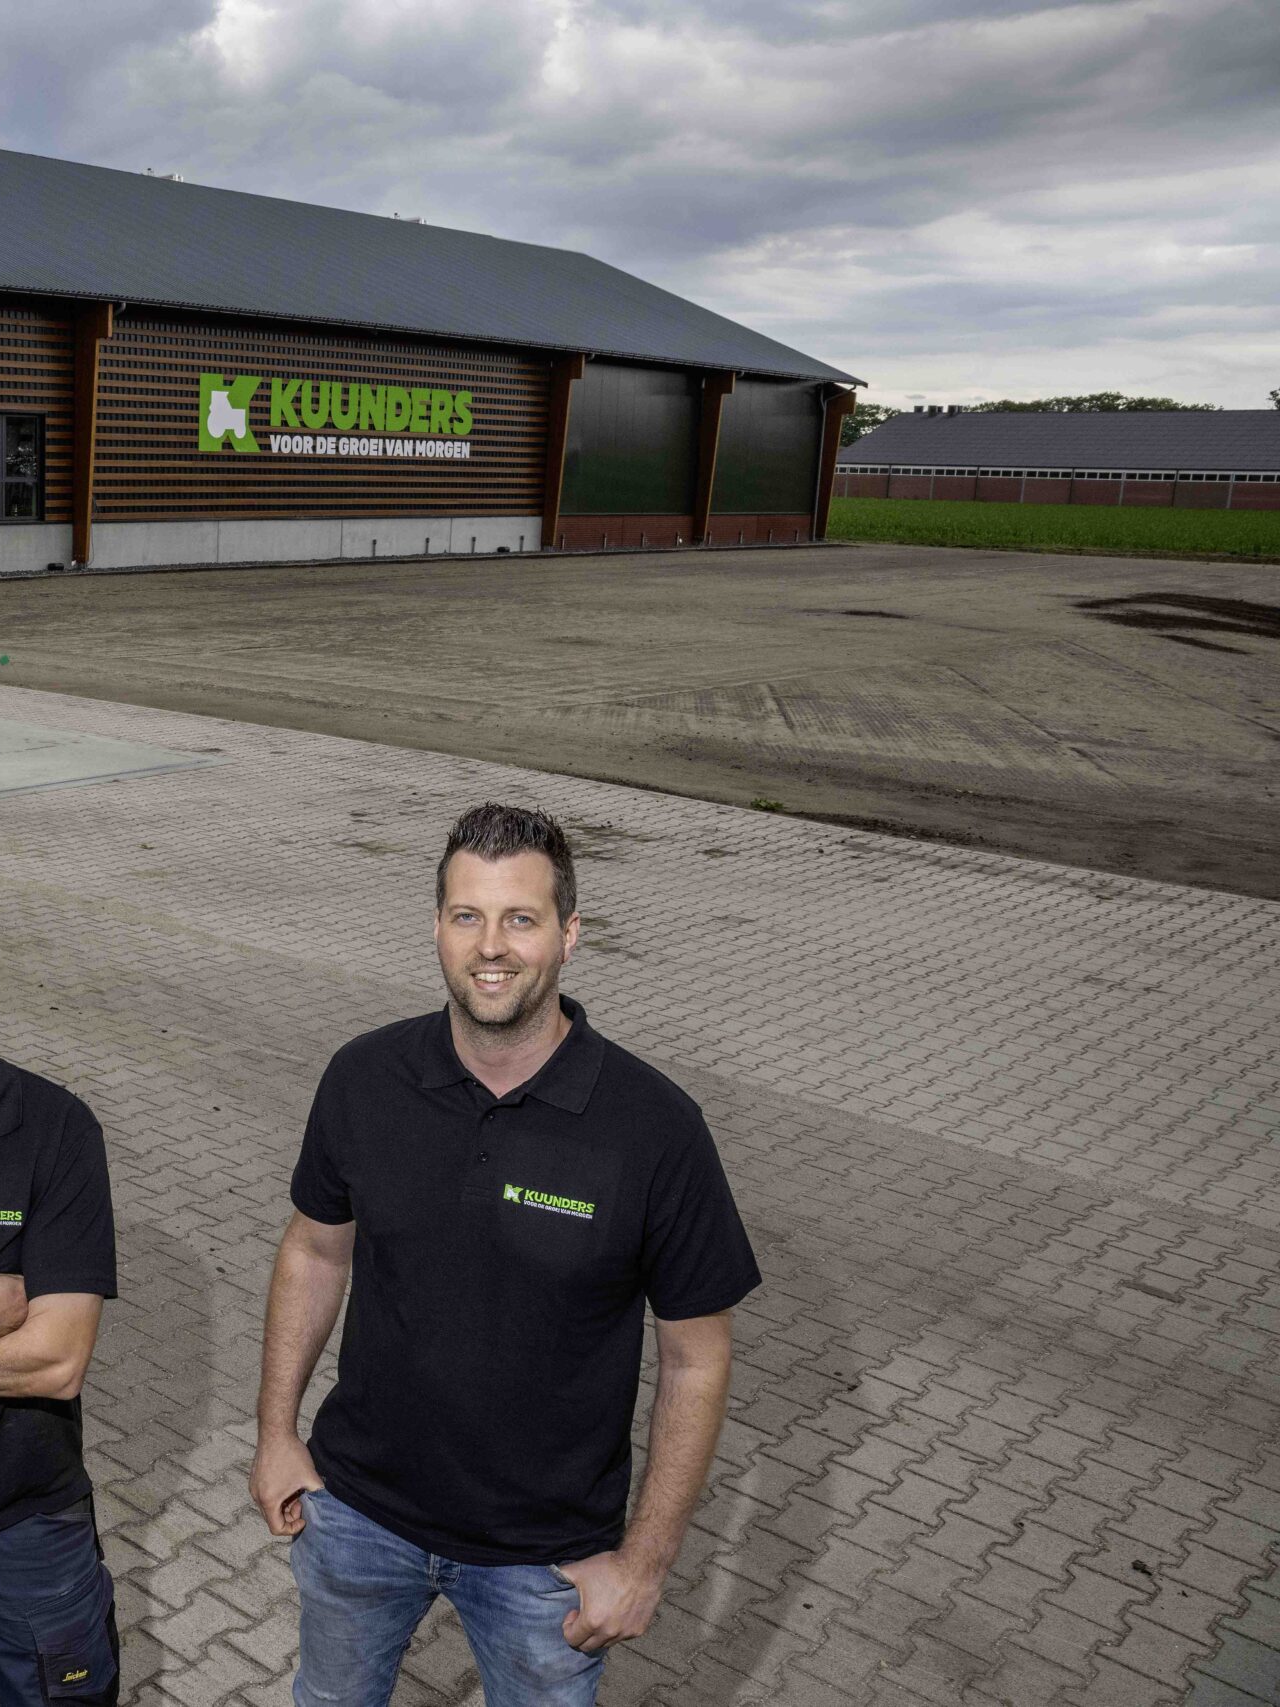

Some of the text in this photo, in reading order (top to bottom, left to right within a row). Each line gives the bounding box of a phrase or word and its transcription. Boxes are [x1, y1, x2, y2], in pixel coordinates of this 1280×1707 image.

[270, 377, 473, 435] KUUNDERS
[269, 435, 471, 459] VOOR DE GROEI VAN MORGEN
[524, 1189, 595, 1213] KUUNDERS
